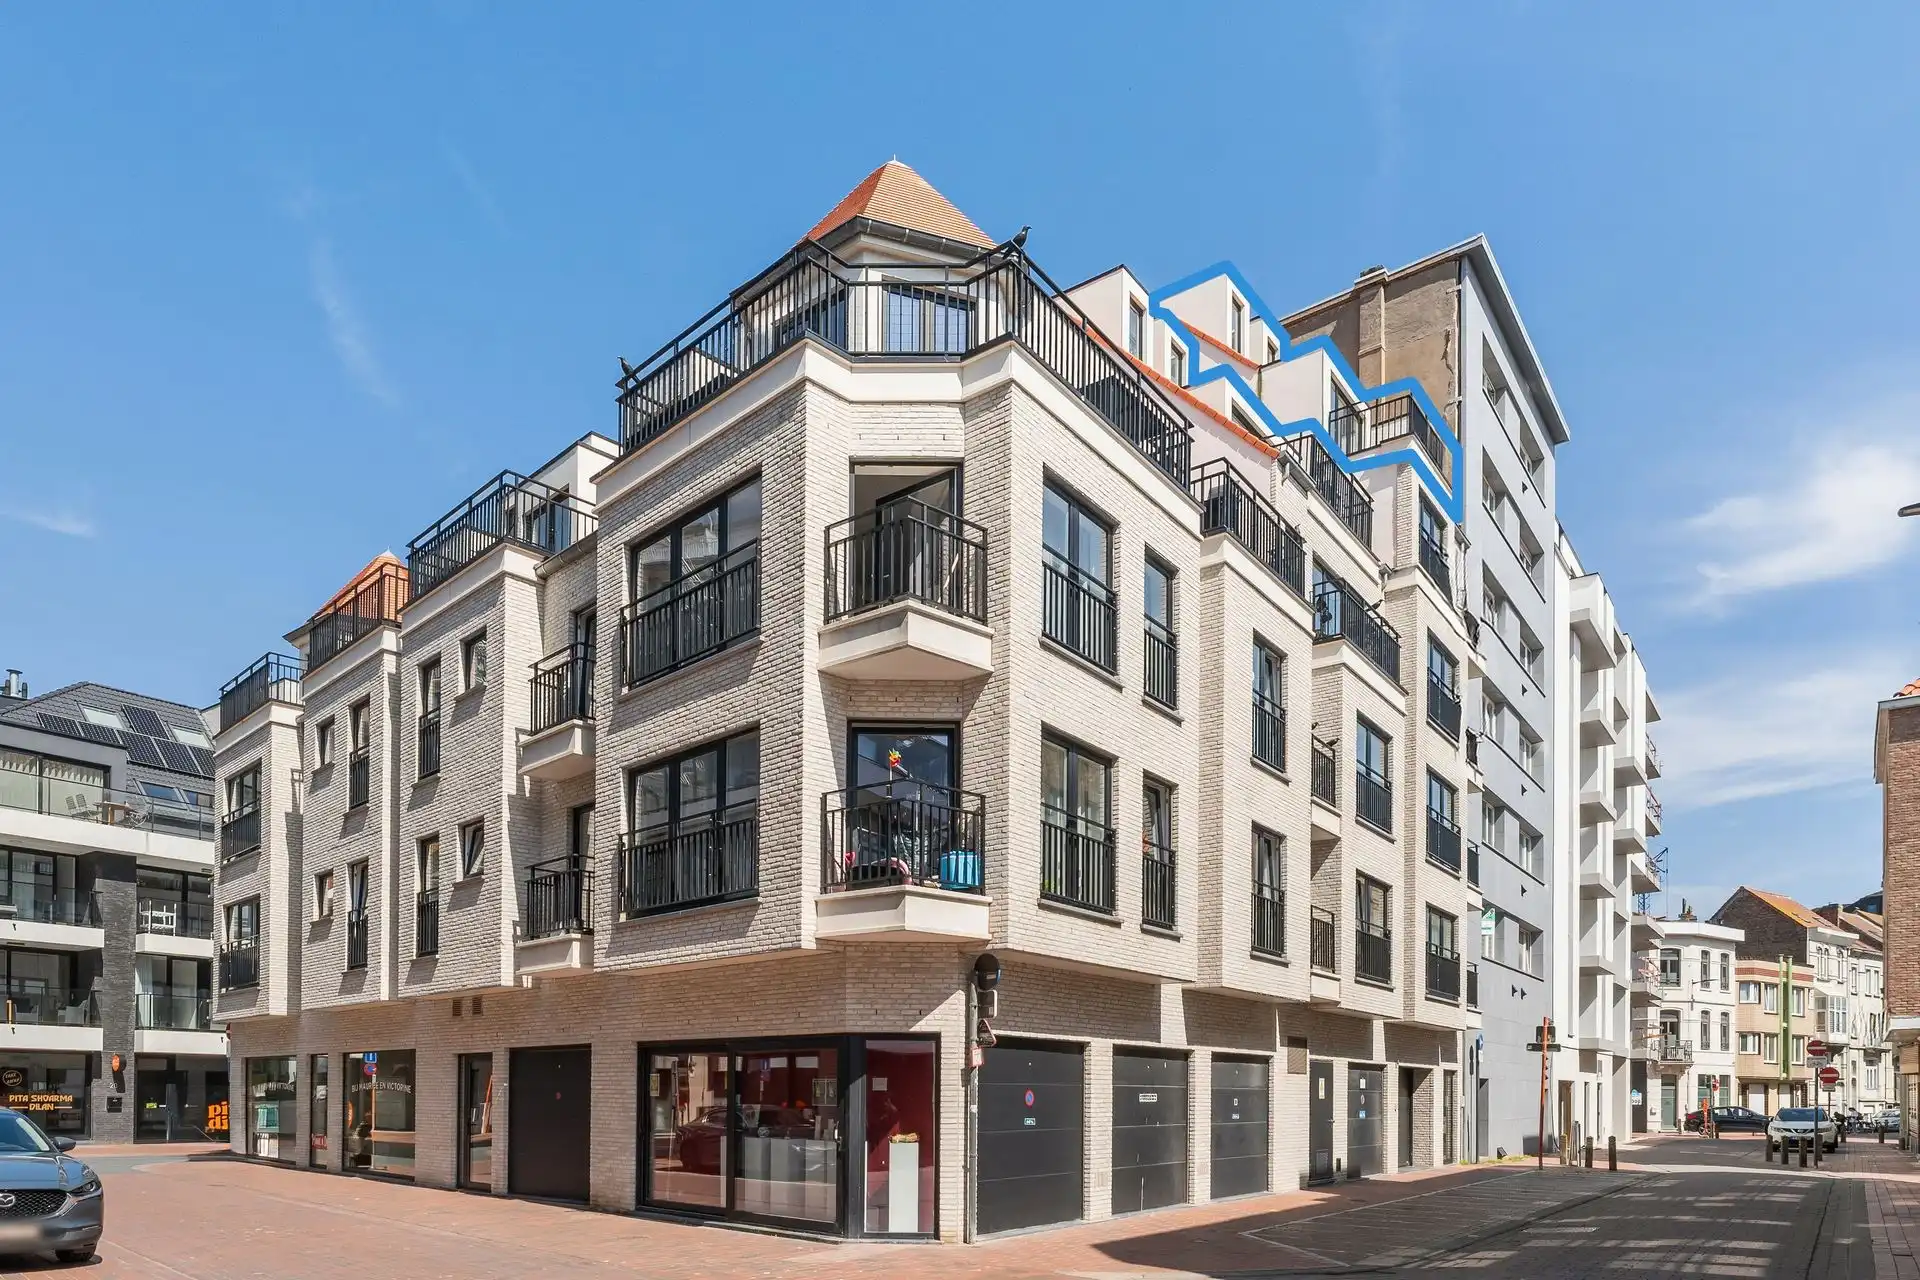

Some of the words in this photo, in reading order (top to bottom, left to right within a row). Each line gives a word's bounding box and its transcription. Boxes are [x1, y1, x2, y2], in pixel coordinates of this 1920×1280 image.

[9, 1094, 29, 1102] PITA
[30, 1094, 73, 1102] SHOARMA
[29, 1103, 54, 1111] DILAN
